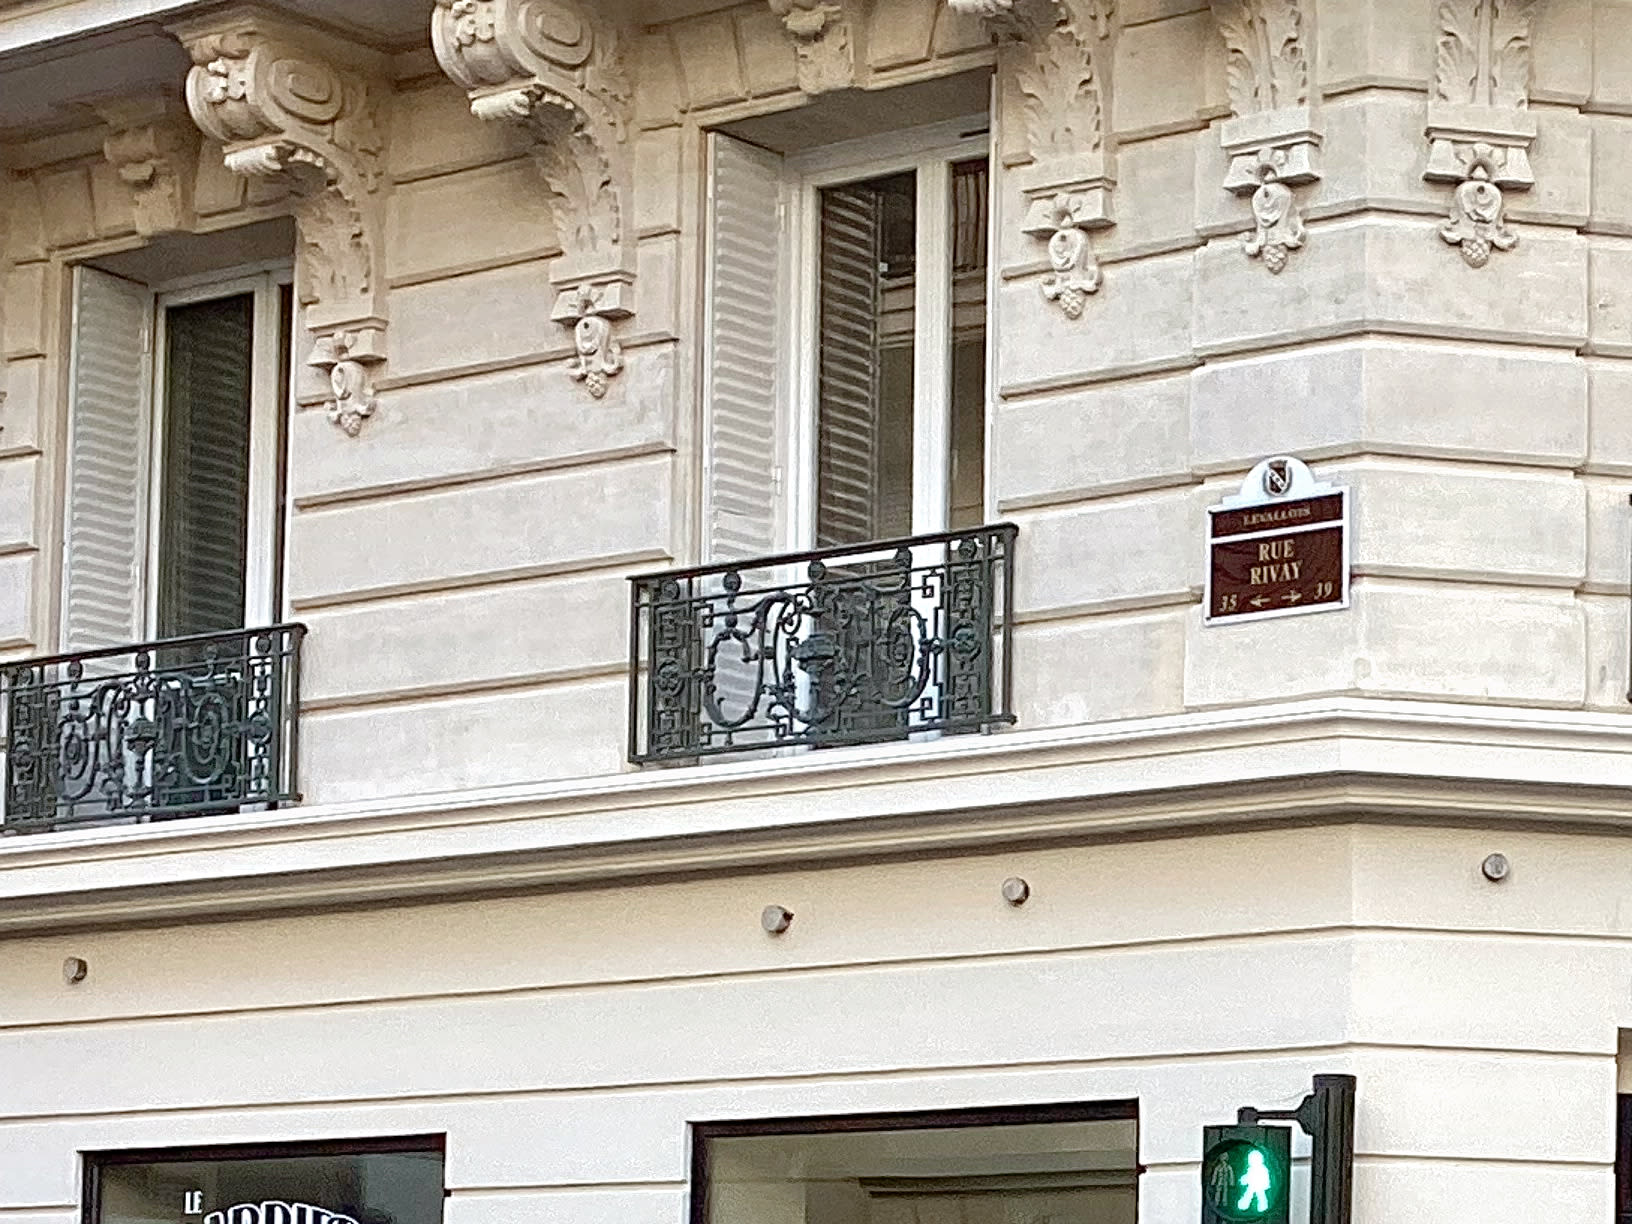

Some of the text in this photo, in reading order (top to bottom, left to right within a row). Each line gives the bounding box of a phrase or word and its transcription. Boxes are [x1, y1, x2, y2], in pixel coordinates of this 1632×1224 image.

[1259, 539, 1294, 560] RUE
[1250, 562, 1302, 584] RIVAY
[1220, 595, 1237, 612] 35
[185, 1191, 203, 1214] LE
